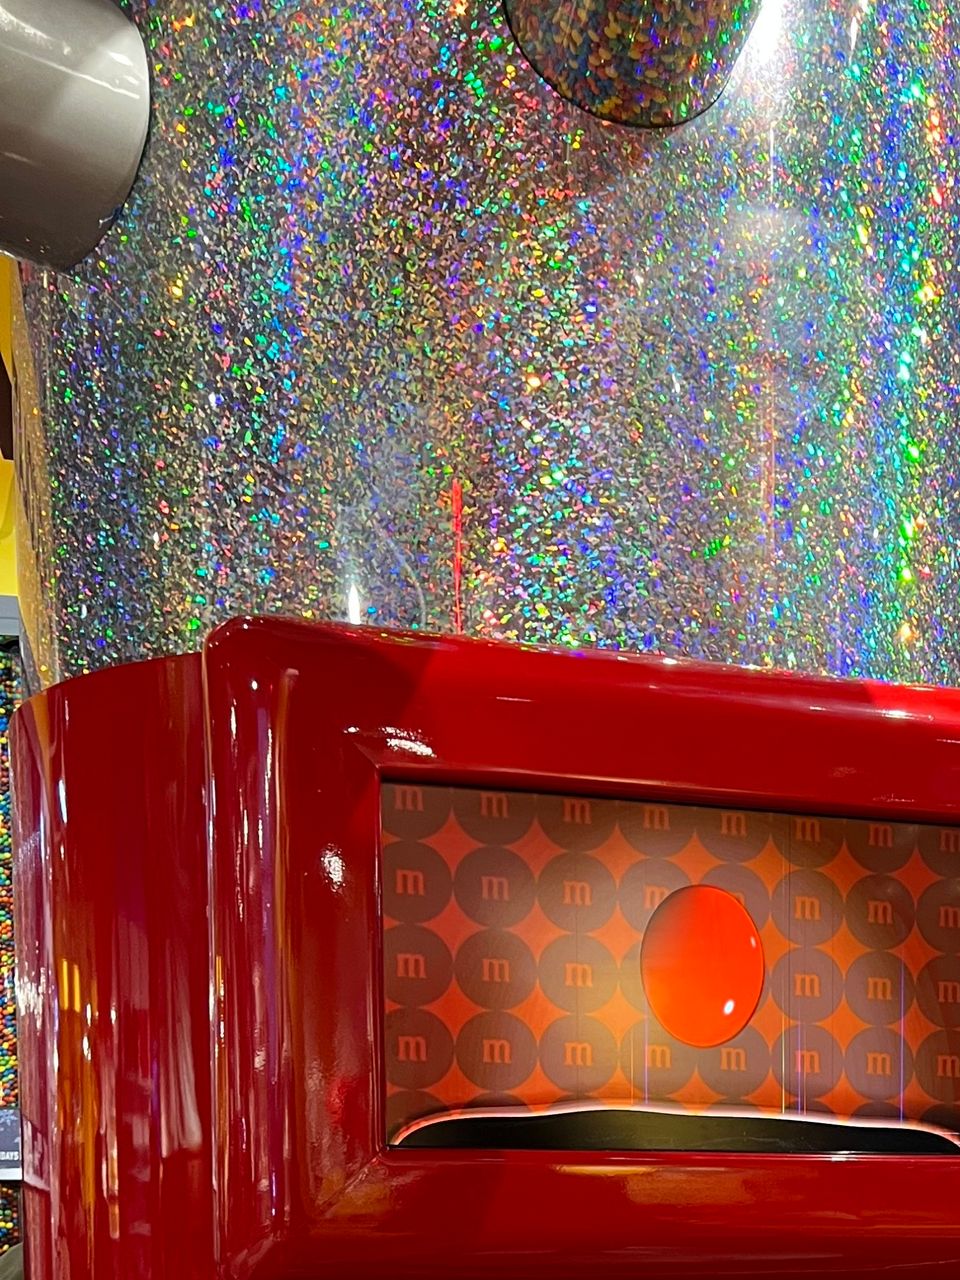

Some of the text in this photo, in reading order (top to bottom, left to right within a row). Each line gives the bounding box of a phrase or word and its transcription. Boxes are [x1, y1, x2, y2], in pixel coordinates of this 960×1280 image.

[395, 785, 424, 812] m
[480, 792, 509, 818] m
[562, 799, 592, 824] m
[643, 806, 670, 831] m
[720, 813, 747, 837] m
[796, 818, 821, 842] m
[868, 824, 893, 848] m
[395, 869, 424, 896] m
[481, 875, 509, 901] m
[562, 880, 592, 906] m
[795, 896, 821, 921] m
[867, 900, 893, 925] m
[396, 953, 960, 1003] m m m m m m
[398, 1035, 960, 1078] m m m m m m m m
